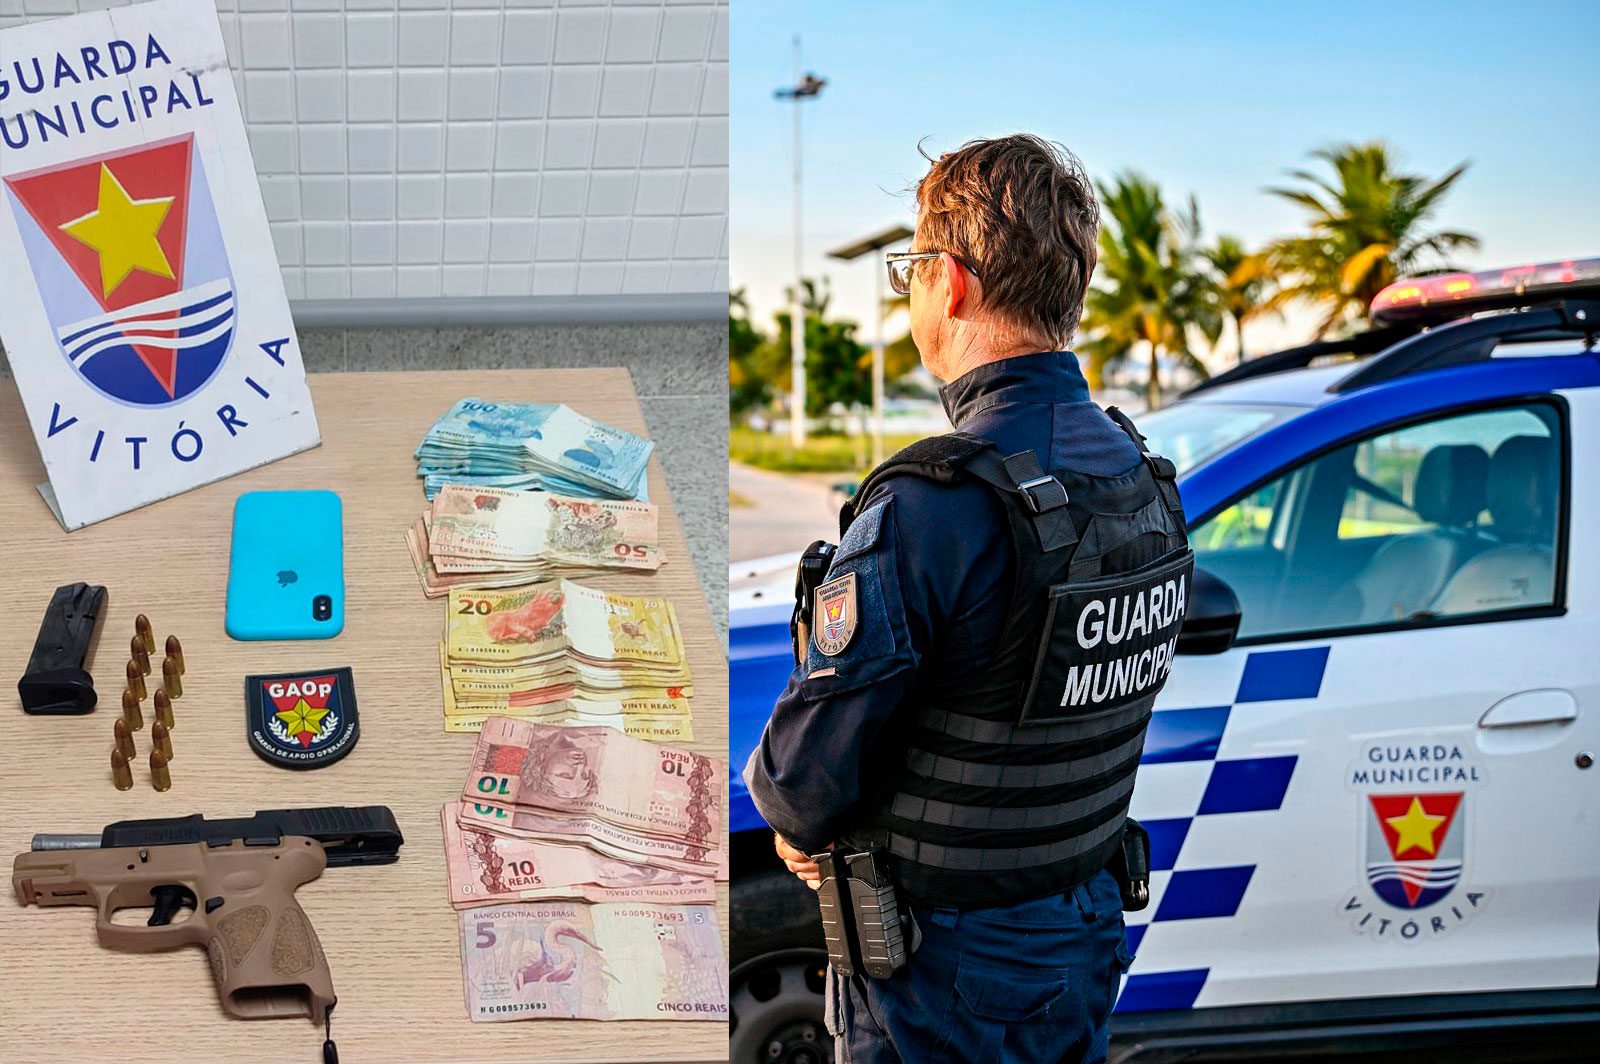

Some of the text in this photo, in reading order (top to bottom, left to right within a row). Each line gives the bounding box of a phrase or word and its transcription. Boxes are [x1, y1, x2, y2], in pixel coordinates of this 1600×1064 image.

[47, 337, 290, 470] VITÓRIA
[461, 401, 498, 412] 100
[614, 543, 649, 558] 50
[457, 599, 493, 616] 20
[1076, 574, 1186, 650] GUARDA
[621, 702, 678, 710] VINTE REAIS
[623, 727, 652, 735] VINTE
[253, 722, 355, 760] GUARDA DE APOIO OPERACIONAL
[660, 750, 690, 763] REAIS
[1368, 745, 1464, 763] GUARDA
[662, 760, 685, 776] 10
[1352, 765, 1480, 785] MUNICIPAL
[477, 775, 510, 795] 10
[508, 860, 535, 877] 10
[508, 876, 542, 888] REAIS
[474, 910, 577, 920] BANCO CENTRAL DO BRASIL
[694, 912, 705, 924] 5
[1344, 892, 1484, 940] VITÓRIA
[475, 921, 497, 949] 5
[656, 1002, 728, 1012] CINCO REAIS
